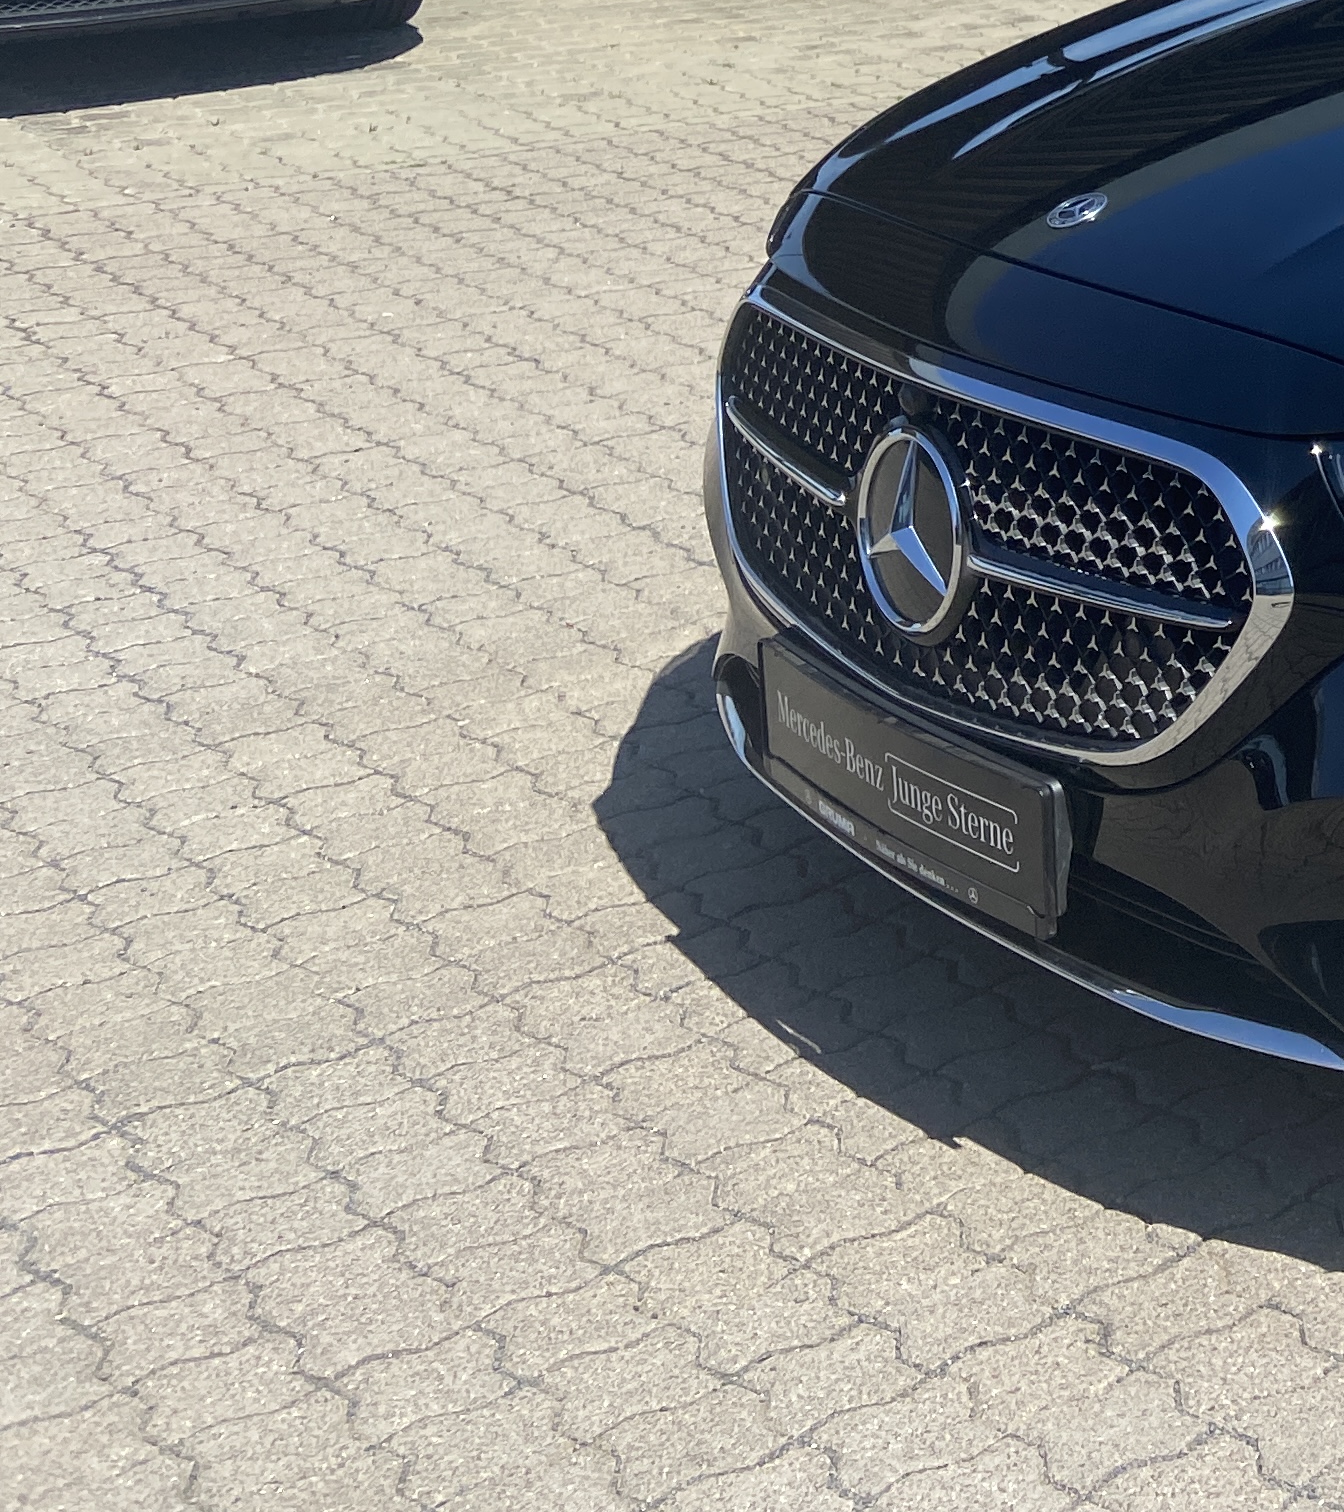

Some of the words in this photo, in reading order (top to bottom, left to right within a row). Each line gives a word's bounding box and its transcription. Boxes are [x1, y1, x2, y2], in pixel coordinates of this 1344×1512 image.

[776, 690, 885, 792] Mercedes-Benz
[891, 764, 943, 825] Junge
[946, 793, 1014, 855] Sterne
